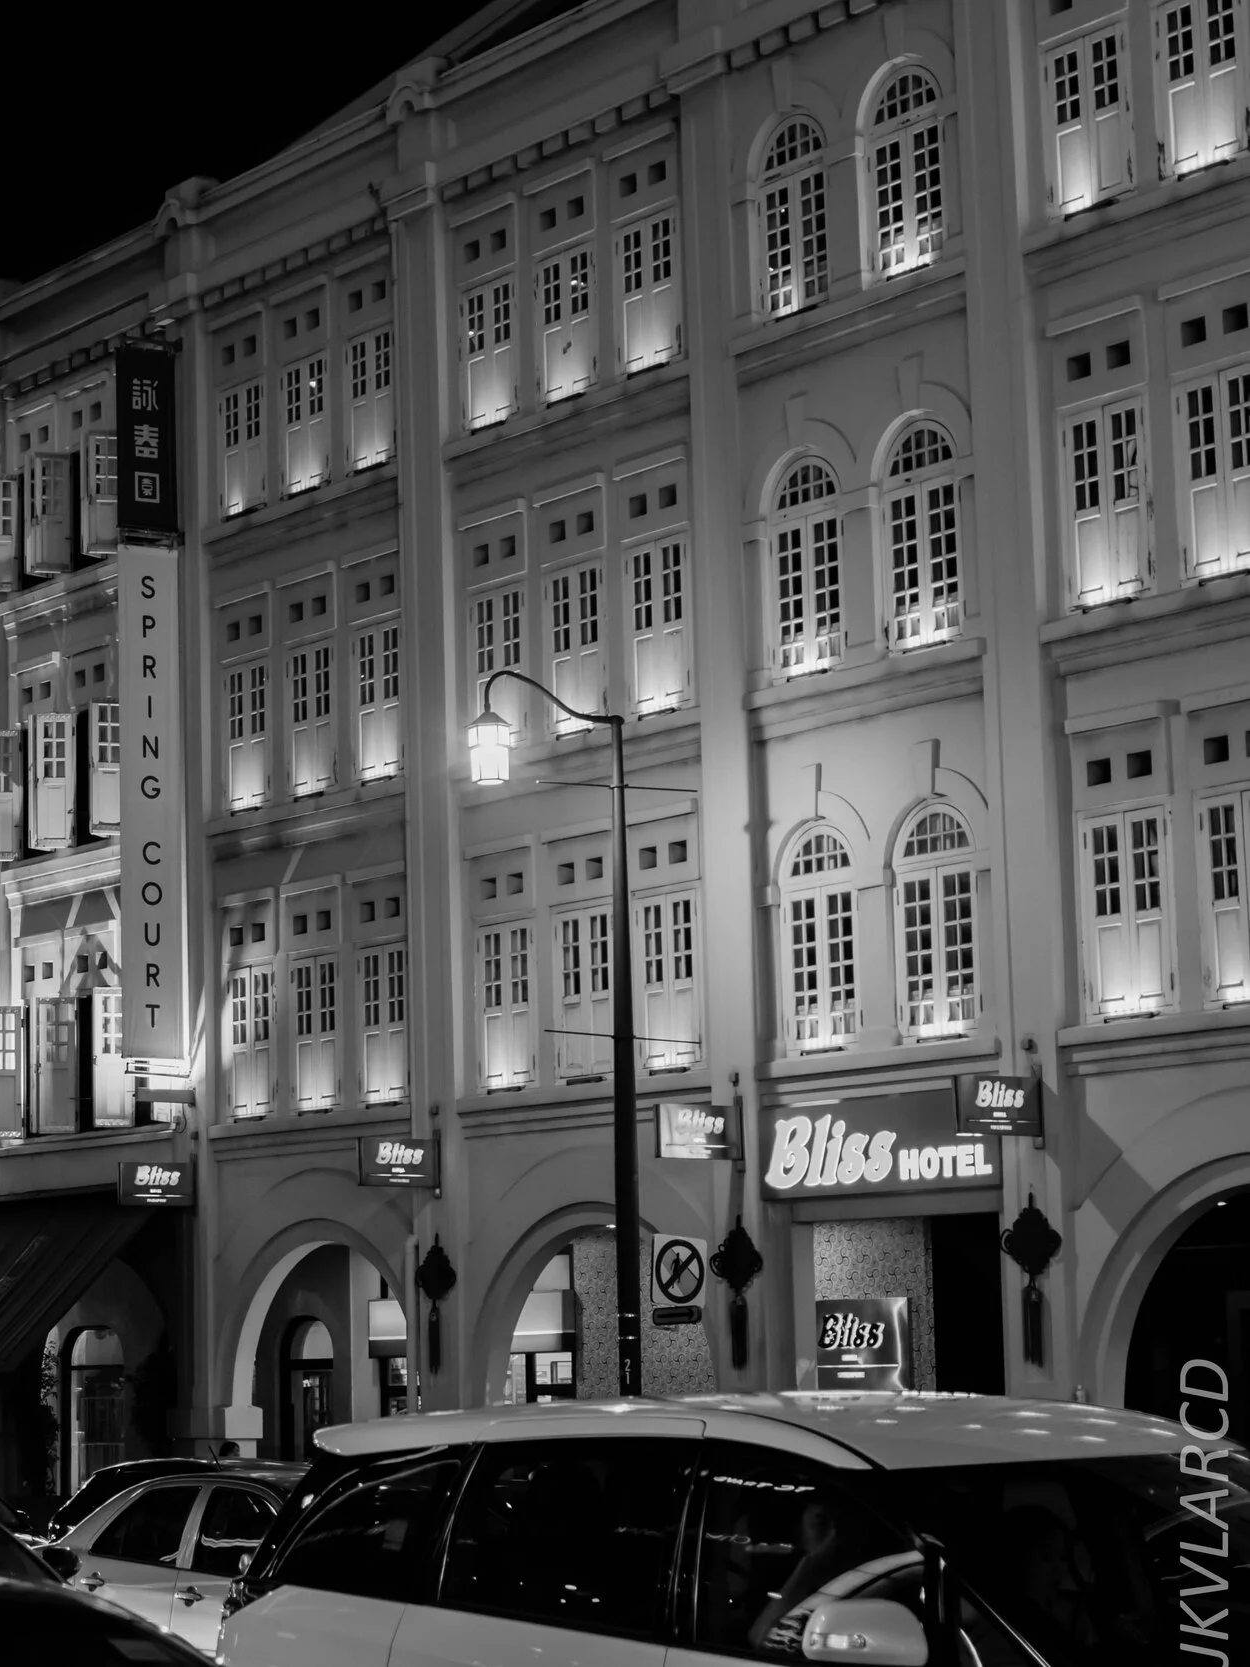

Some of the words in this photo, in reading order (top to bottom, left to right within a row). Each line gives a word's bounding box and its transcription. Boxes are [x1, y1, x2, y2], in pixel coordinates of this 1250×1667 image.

[140, 575, 162, 800] SPRING
[141, 841, 163, 1030] COURT
[975, 1080, 1026, 1109] Bliss
[676, 1108, 726, 1136] Bliss
[375, 1141, 425, 1165] Bliss
[764, 1114, 898, 1190] Bliss
[899, 1143, 993, 1181] HOTEL
[133, 1165, 182, 1187] Bliss
[817, 1312, 886, 1351] Bliss
[624, 1358, 631, 1385] 21
